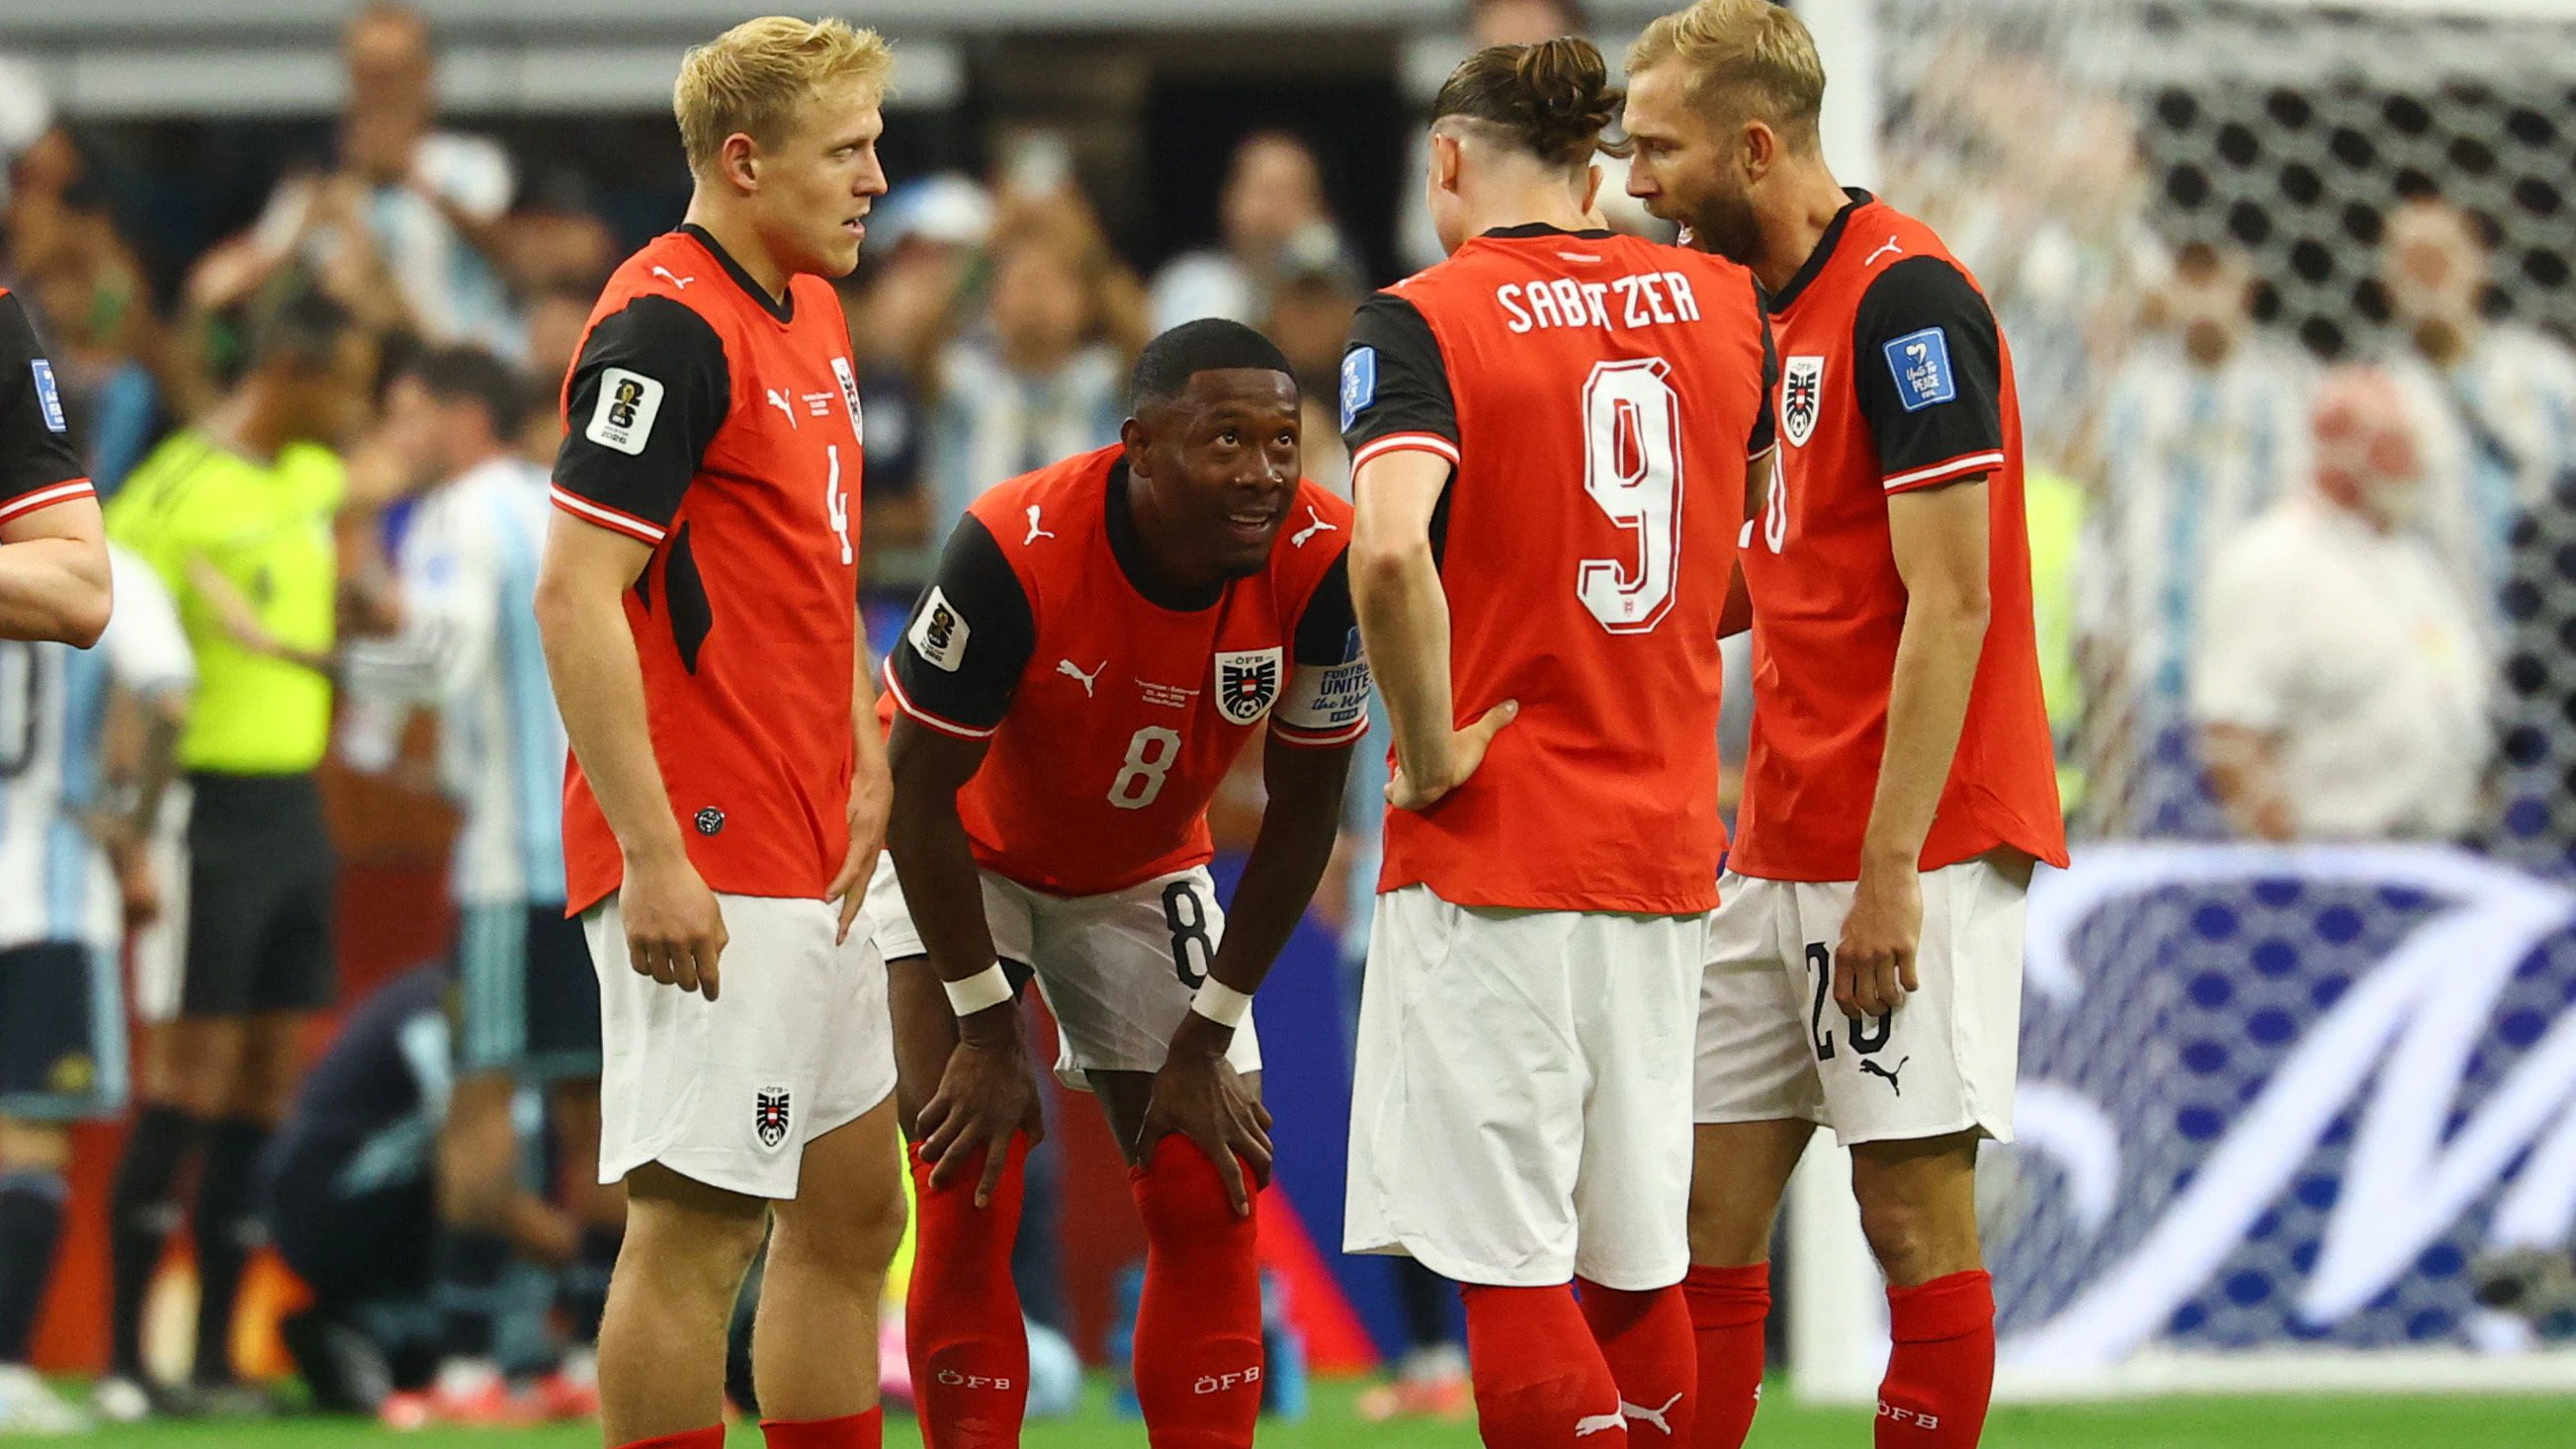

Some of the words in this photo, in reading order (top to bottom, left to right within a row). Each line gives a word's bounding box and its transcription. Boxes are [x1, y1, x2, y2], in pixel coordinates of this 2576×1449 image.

[1912, 374, 1940, 392] PEACE
[601, 431, 627, 445] 2026
[1577, 357, 1683, 635] 9
[1236, 656, 1263, 665] ÖFB
[1321, 672, 1373, 696] UNITE
[1107, 725, 1181, 810] 8
[1161, 881, 1215, 990] 8
[938, 1370, 1010, 1390] ÖFB
[1194, 1366, 1259, 1395] ÖFB
[1878, 1399, 1938, 1429] ÖFB
